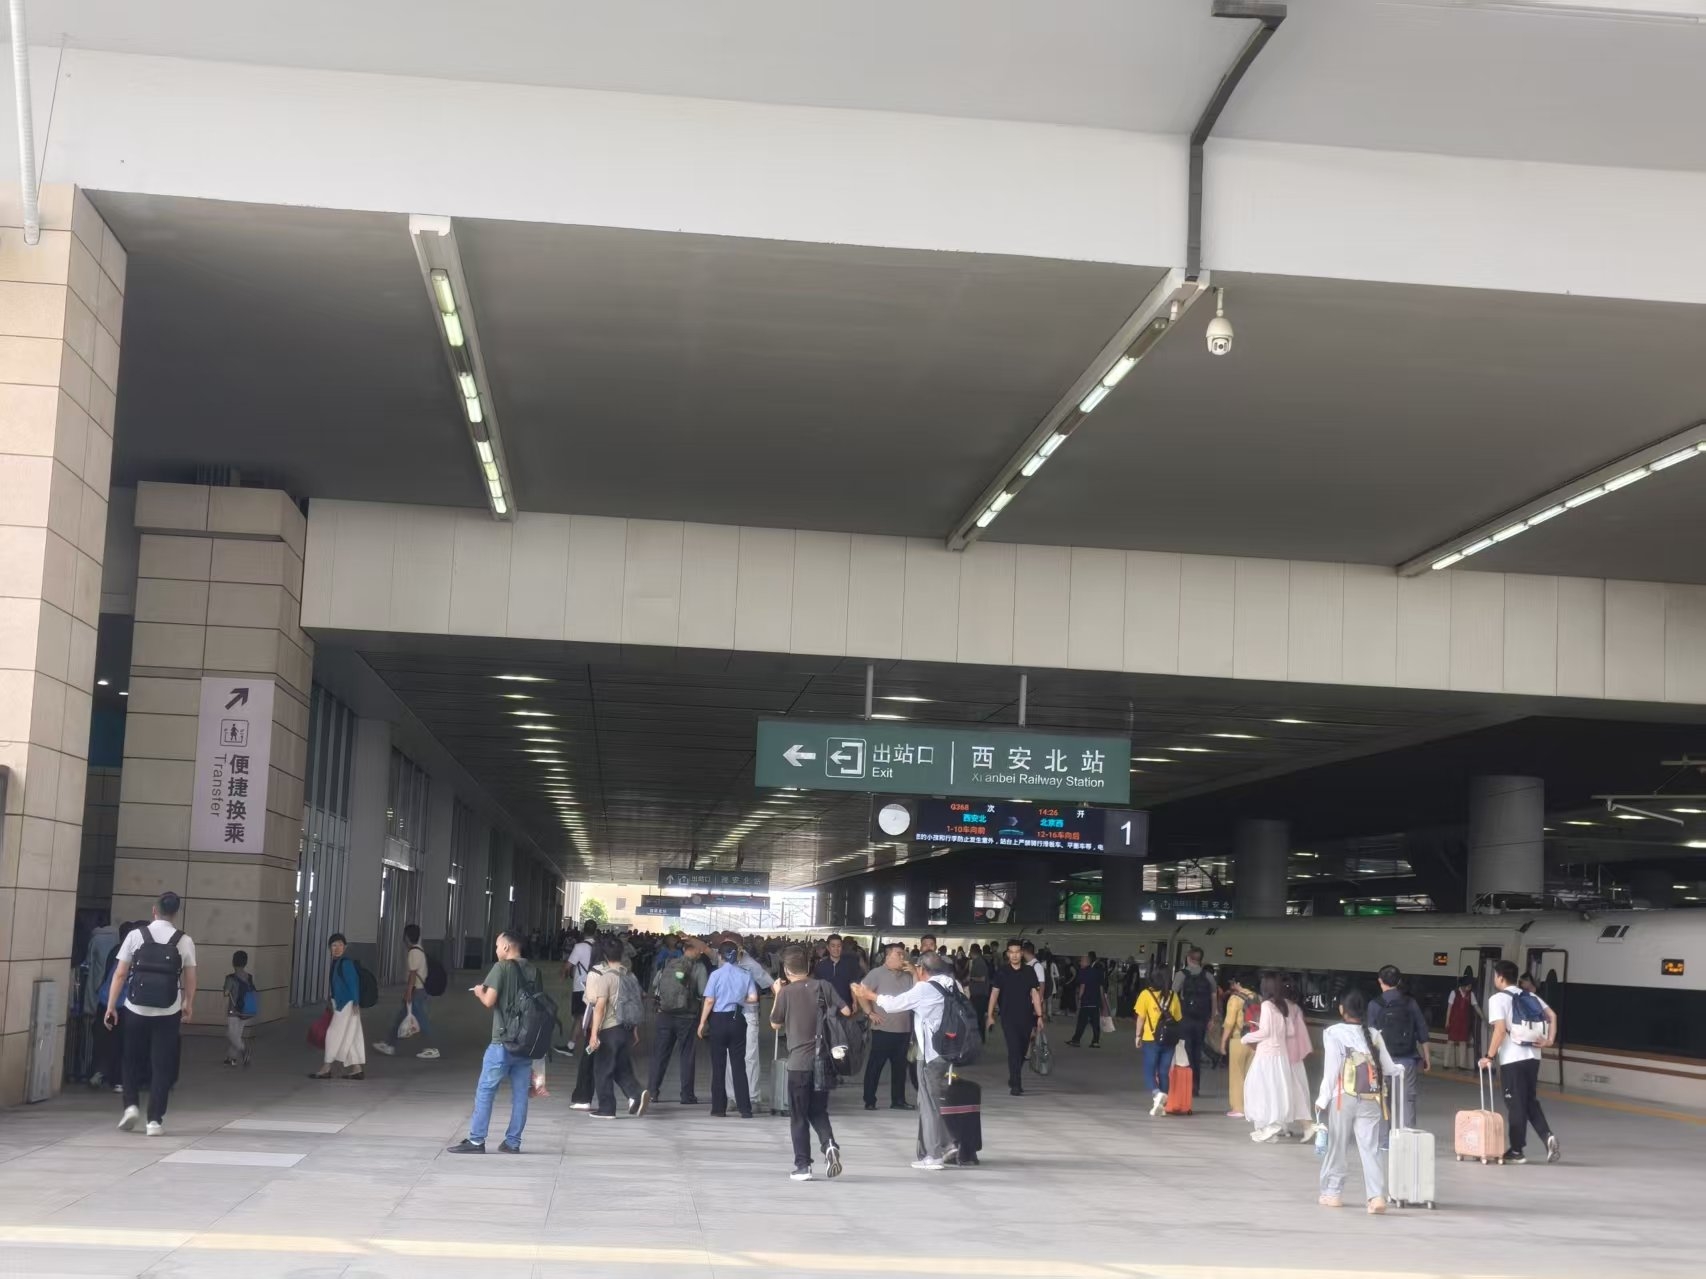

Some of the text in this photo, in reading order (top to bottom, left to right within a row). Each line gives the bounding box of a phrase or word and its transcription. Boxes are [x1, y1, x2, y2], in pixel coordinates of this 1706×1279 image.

[872, 743, 934, 765] 出站口
[971, 745, 1105, 774] 西安北站
[872, 766, 893, 778] Exit
[211, 754, 227, 817] Transfer
[1019, 773, 1063, 788] Railway
[1065, 775, 1105, 788] Station
[224, 755, 249, 843] 便捷换乘
[986, 803, 996, 813] 次
[1038, 808, 1085, 818] 14:26 开
[962, 813, 987, 823] 西安北
[1039, 818, 1064, 828] 北京西
[1120, 820, 1131, 846] 1
